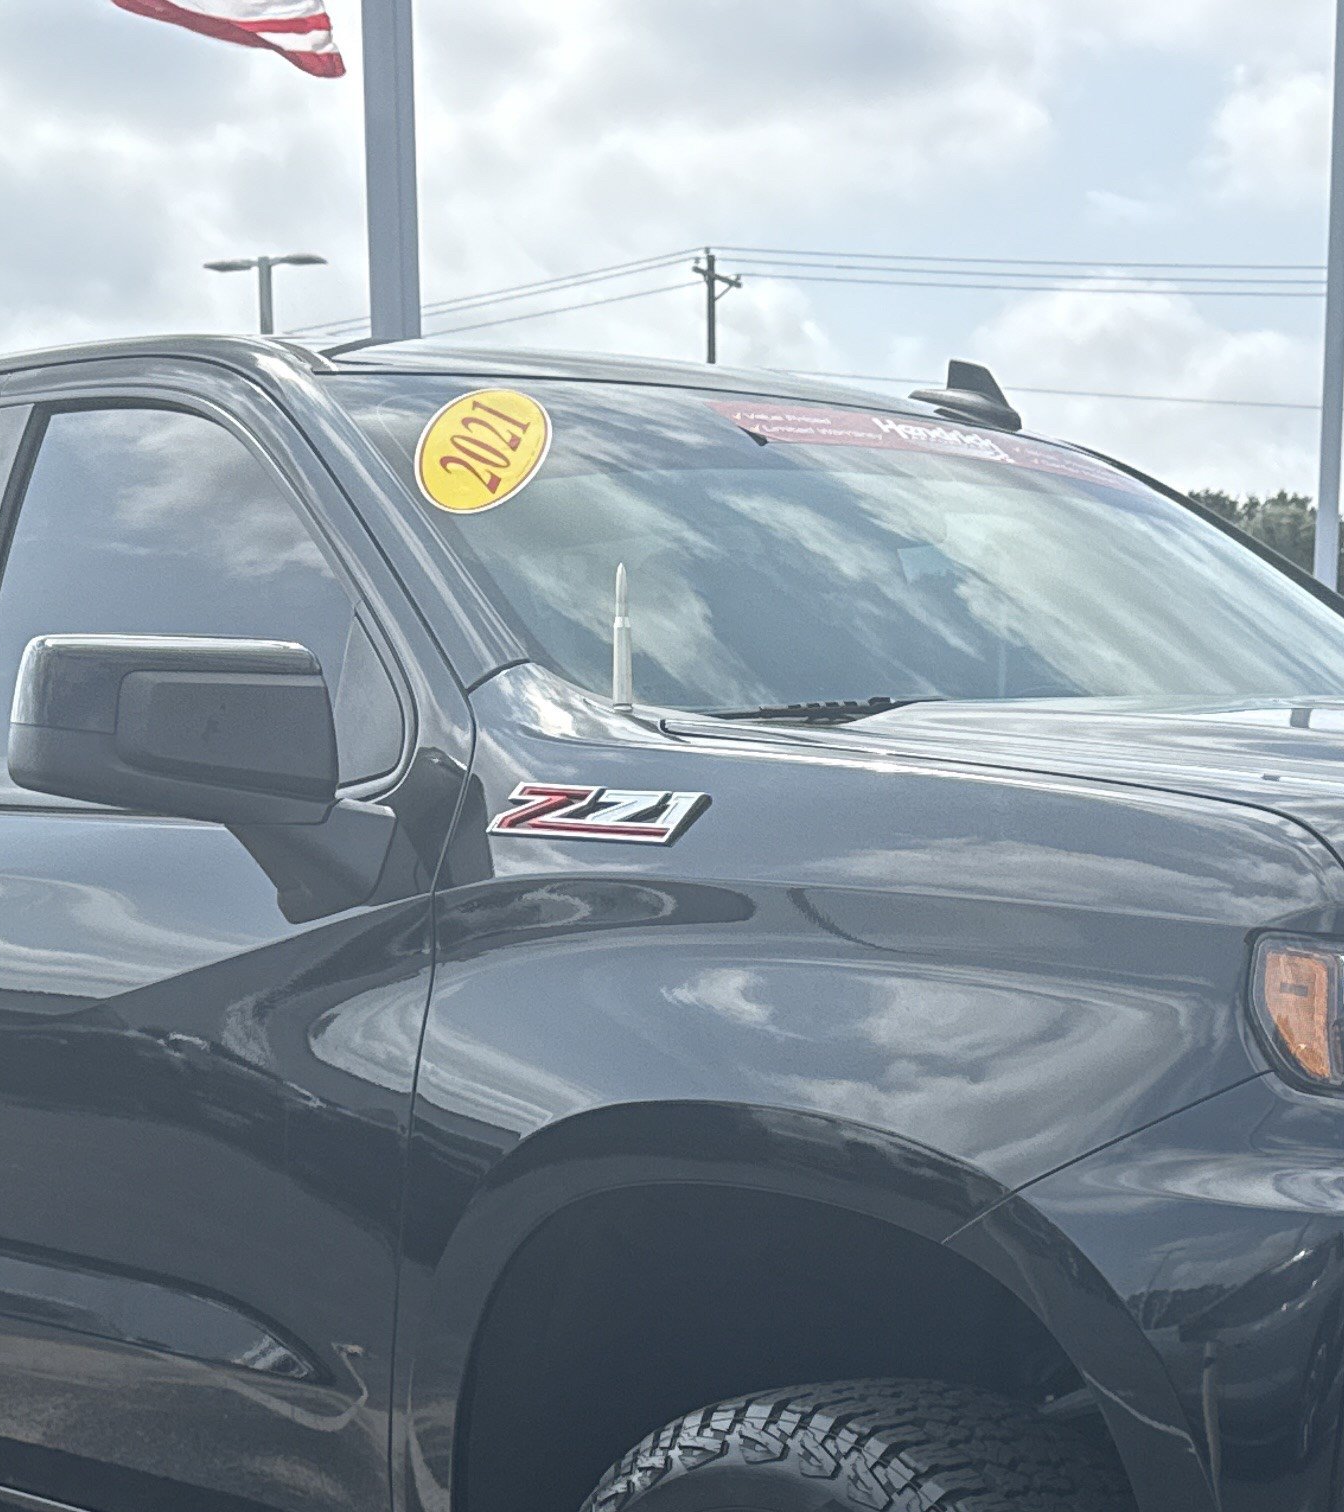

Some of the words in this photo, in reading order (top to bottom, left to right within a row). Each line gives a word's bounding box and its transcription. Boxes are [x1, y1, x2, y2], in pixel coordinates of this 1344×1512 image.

[439, 400, 531, 494] 2021
[872, 417, 1016, 463] Hendrick
[486, 781, 713, 847] Z71
